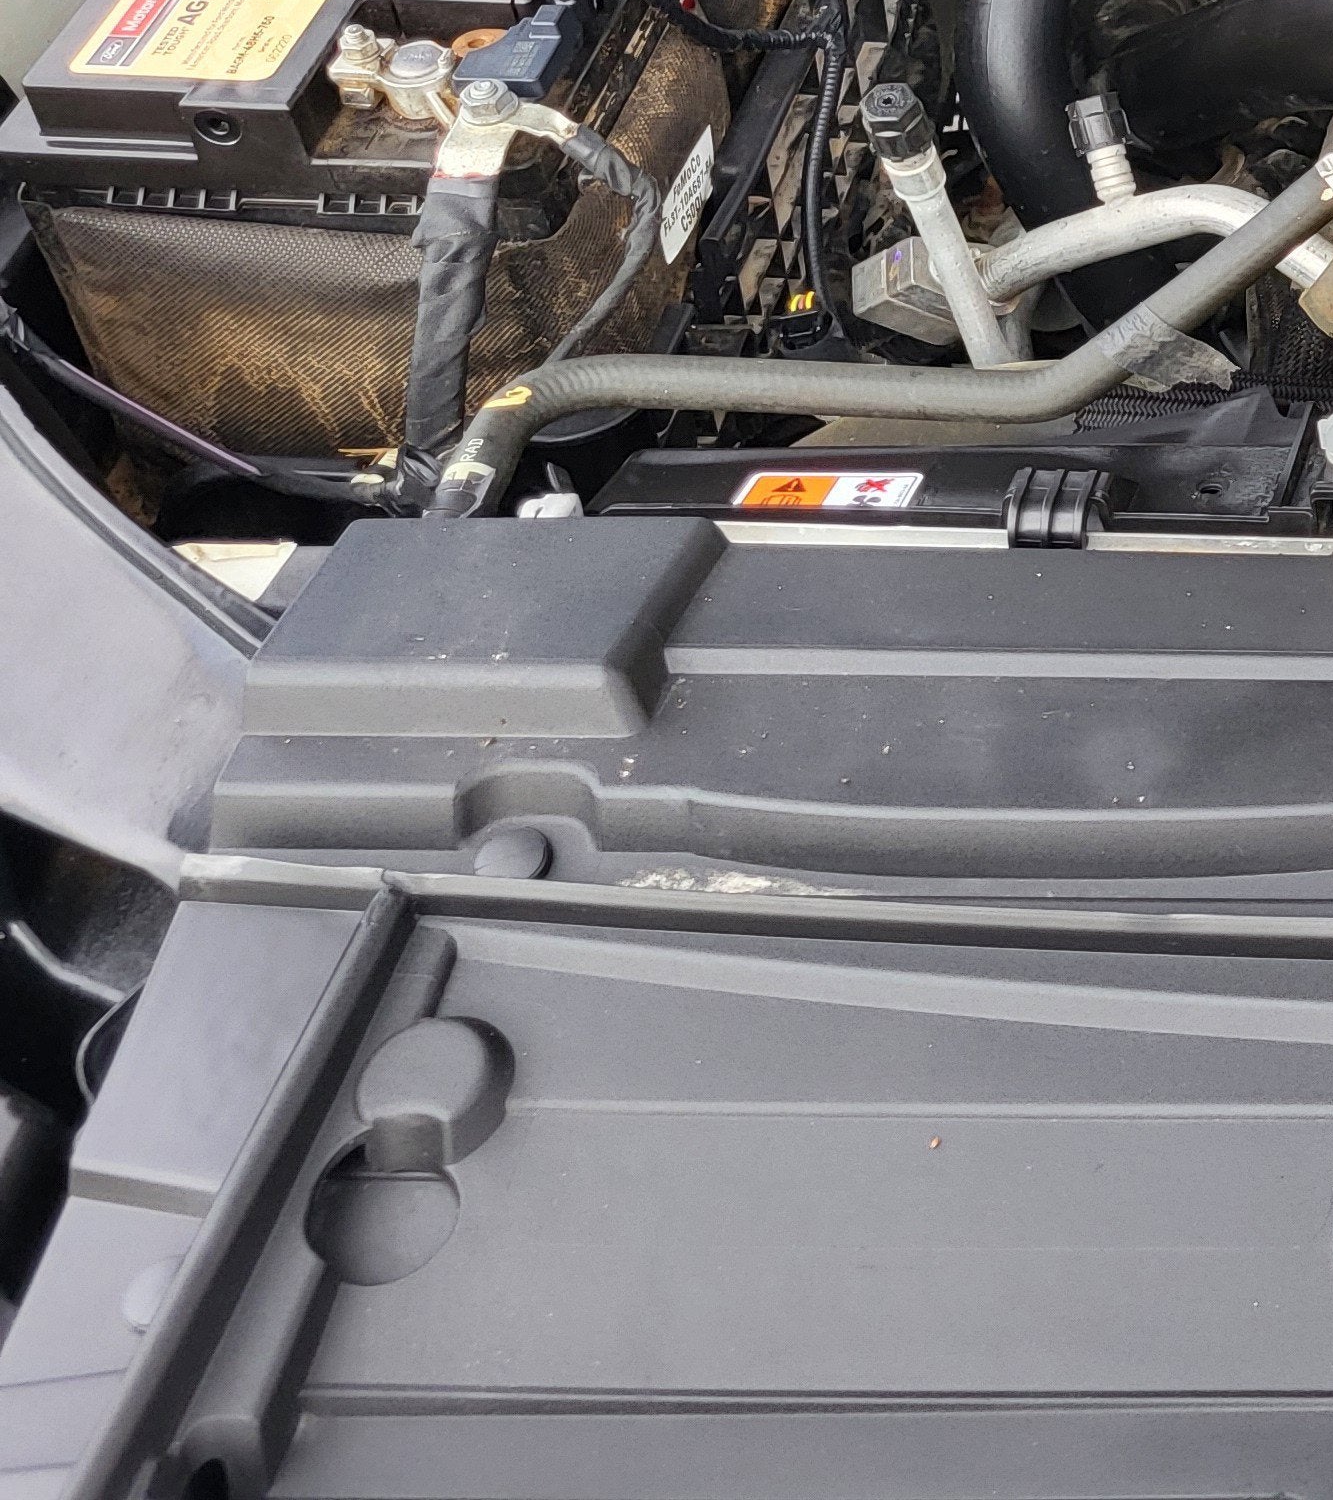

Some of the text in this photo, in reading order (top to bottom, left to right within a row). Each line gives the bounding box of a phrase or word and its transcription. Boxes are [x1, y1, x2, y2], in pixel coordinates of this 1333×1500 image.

[150, 25, 181, 55] TESTED
[672, 154, 701, 203] FoMoCo
[460, 438, 484, 462] RAD
